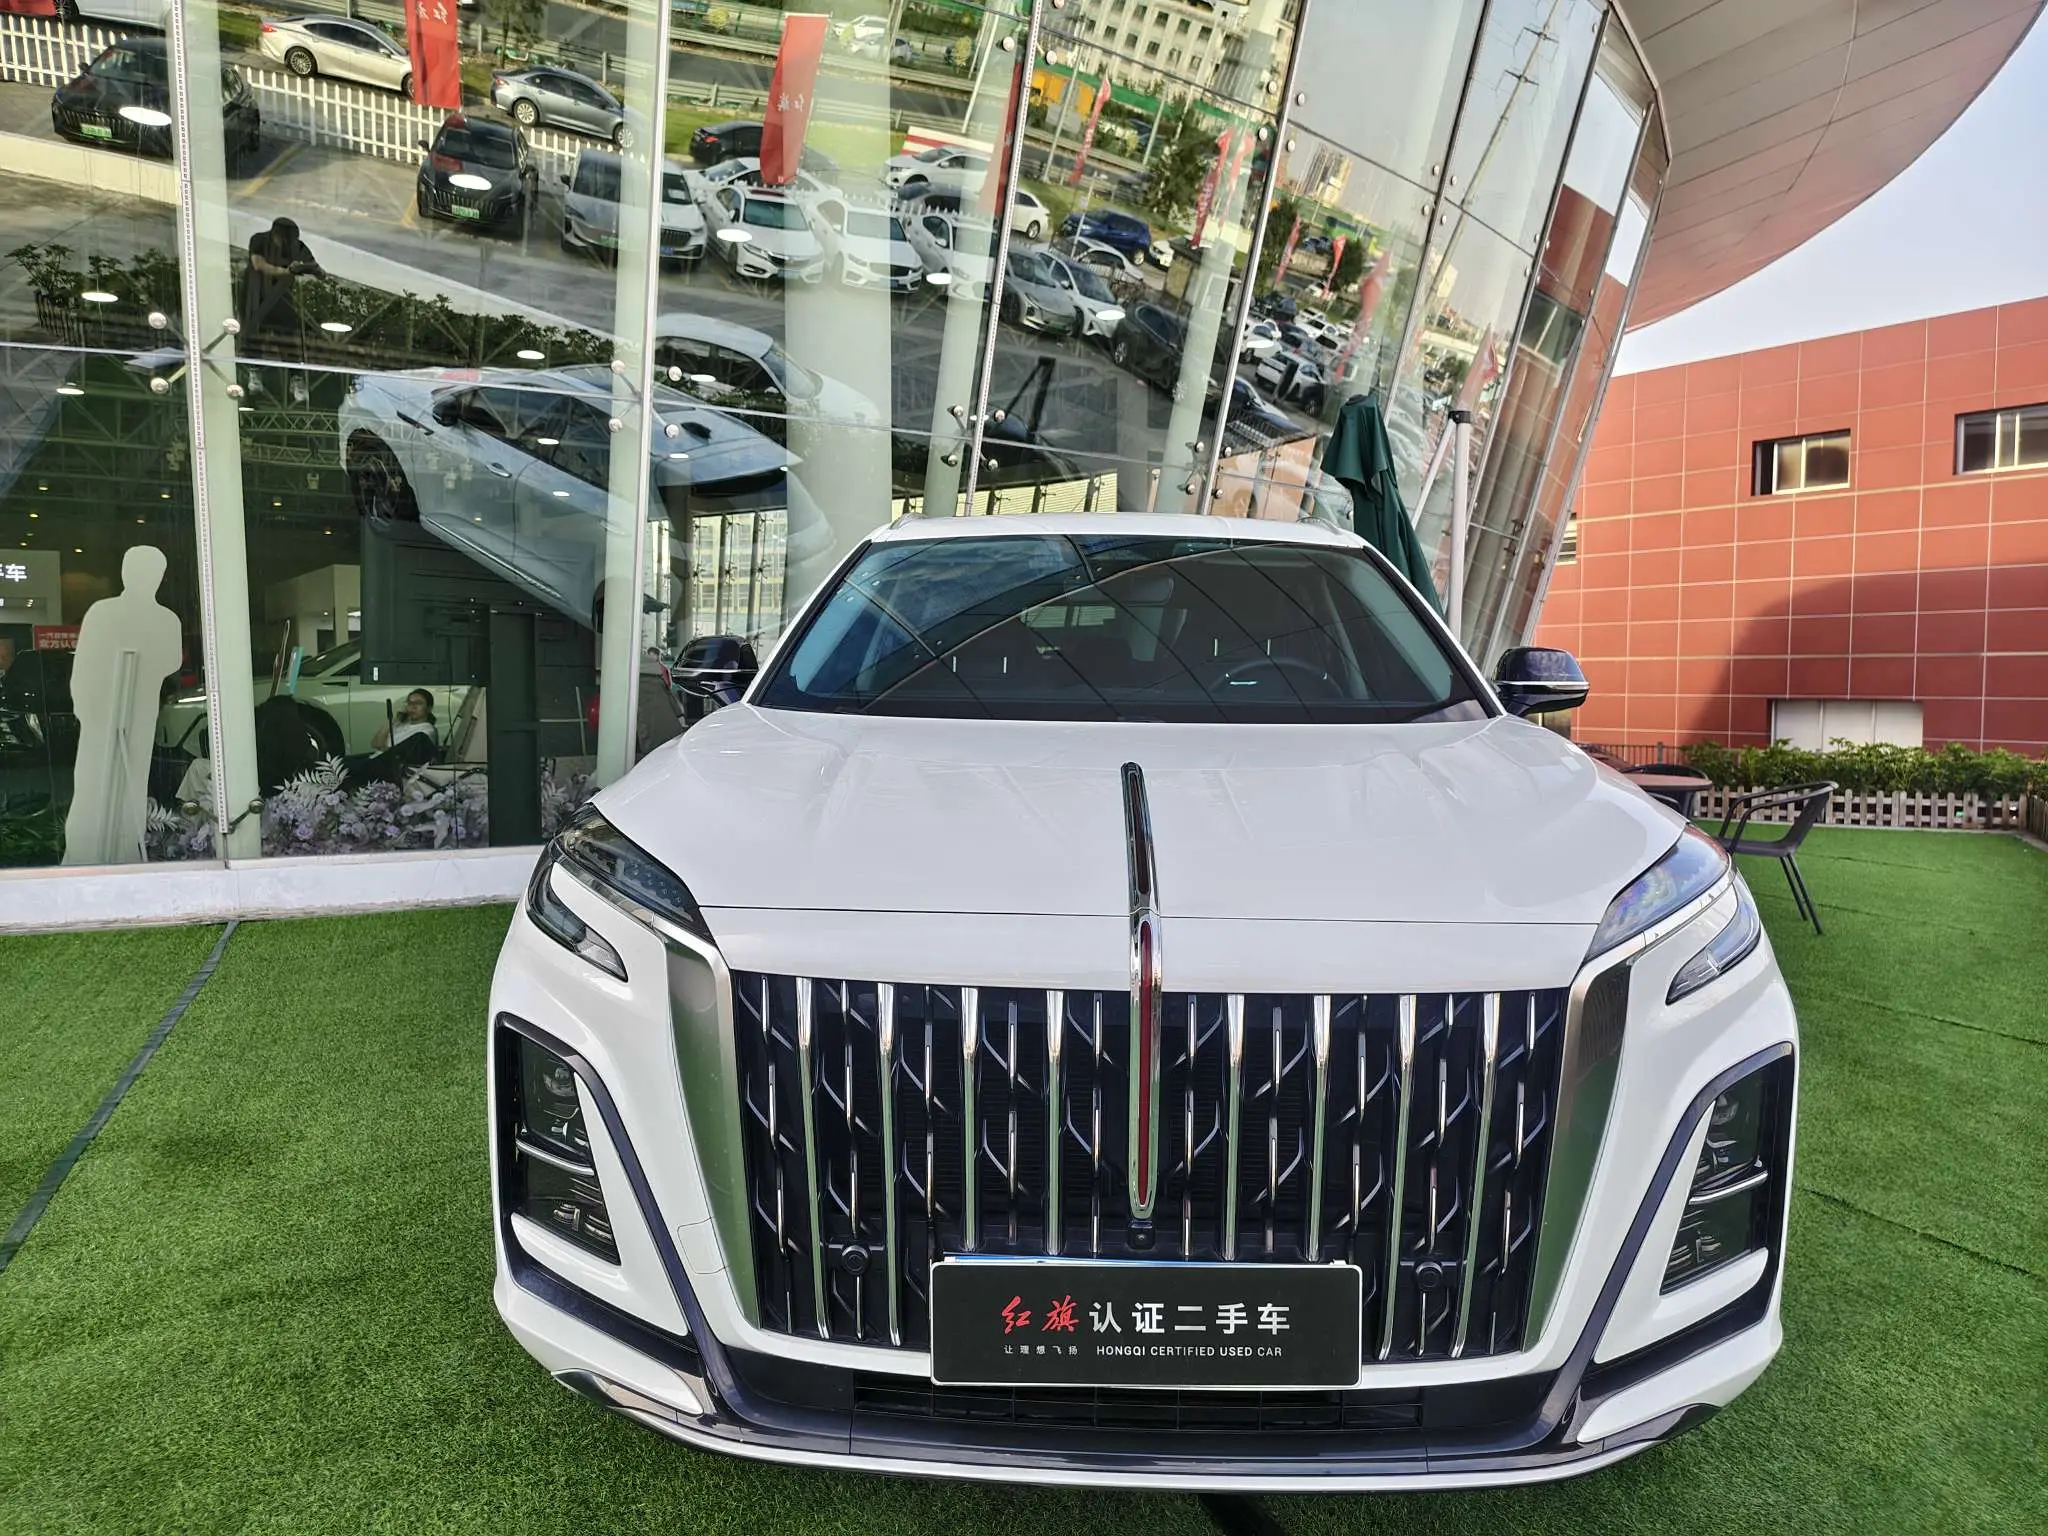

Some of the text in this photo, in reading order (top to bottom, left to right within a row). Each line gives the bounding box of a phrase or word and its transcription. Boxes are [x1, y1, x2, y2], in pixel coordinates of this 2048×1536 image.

[0, 563, 28, 582] 车
[1003, 1344, 1079, 1356] 让理想飞扬
[1096, 1345, 1282, 1357] HONGQI CERTIFIED USED CAR
